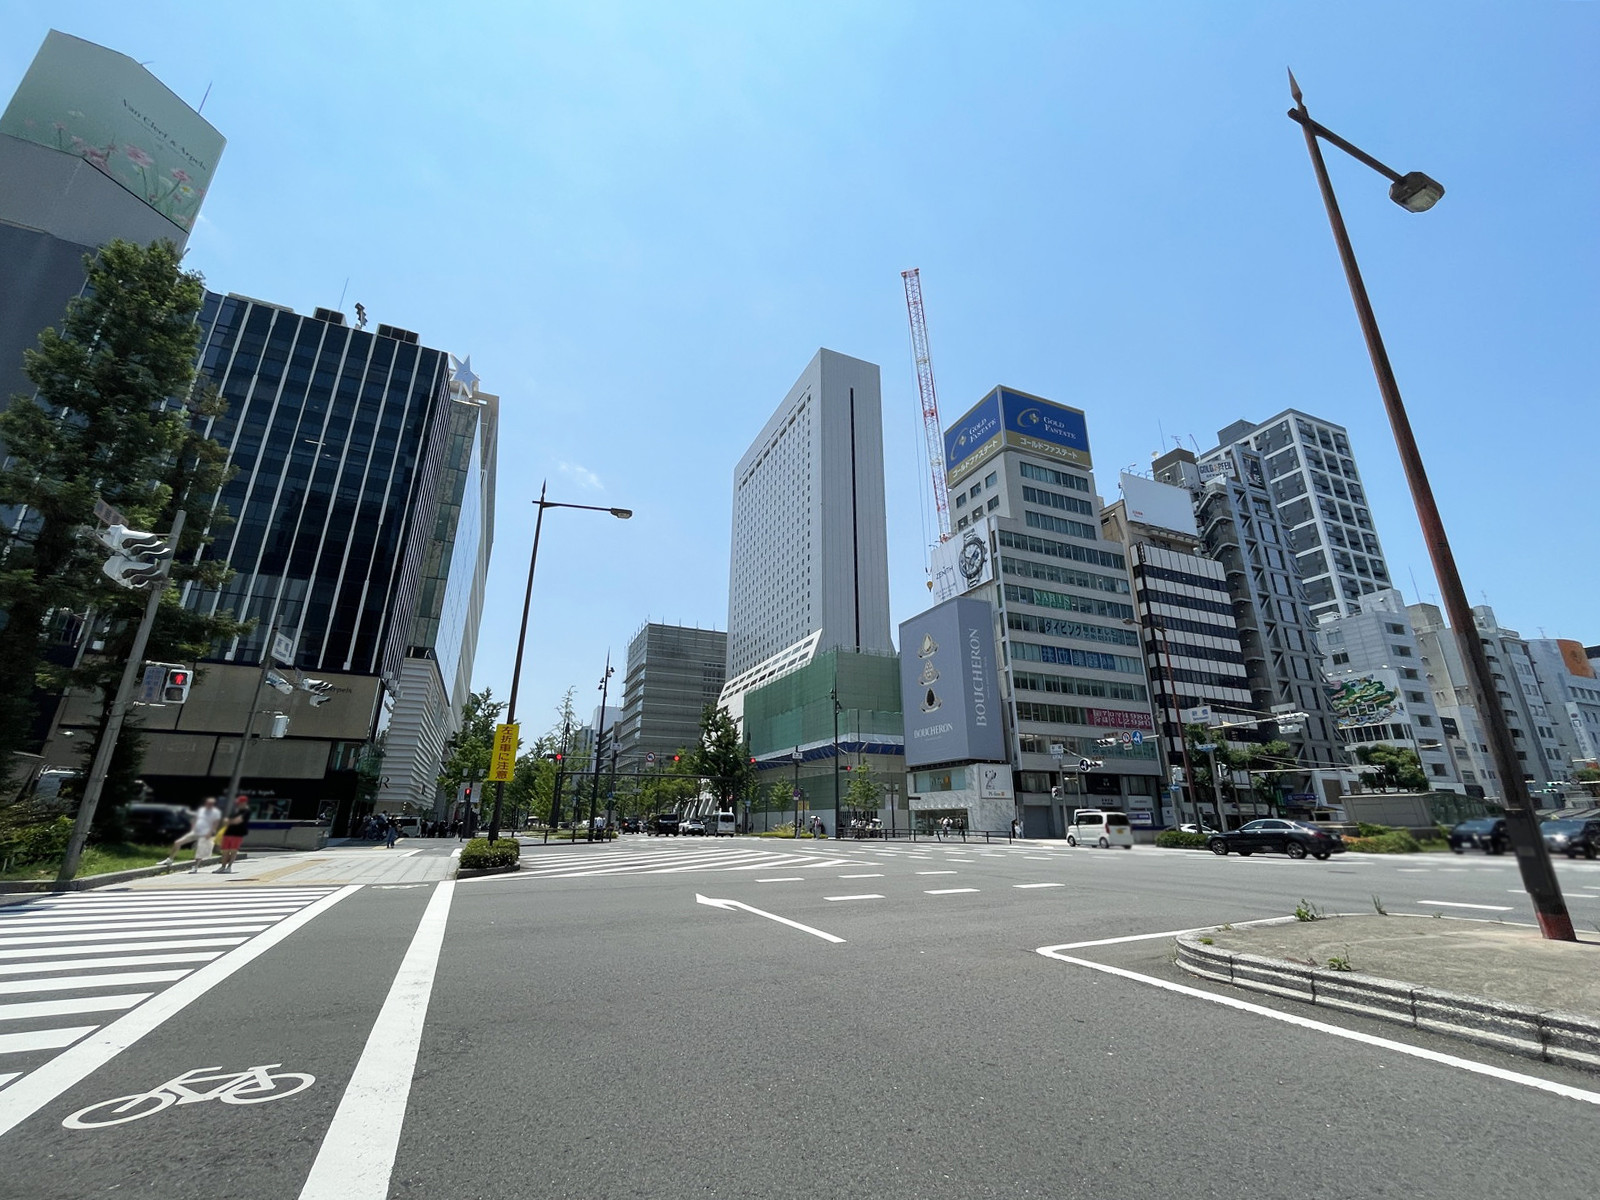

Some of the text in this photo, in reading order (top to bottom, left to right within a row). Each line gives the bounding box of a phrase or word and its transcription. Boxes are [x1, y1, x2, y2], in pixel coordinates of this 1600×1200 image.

[969, 418, 987, 435] GOLD
[1043, 416, 1065, 428] GOLD
[1033, 589, 1071, 605] NARIS
[1045, 620, 1082, 637] ダイビング
[968, 628, 987, 727] BOUCHERON
[913, 723, 953, 739] BOUCHERON
[496, 726, 514, 780] 左折車に注意
